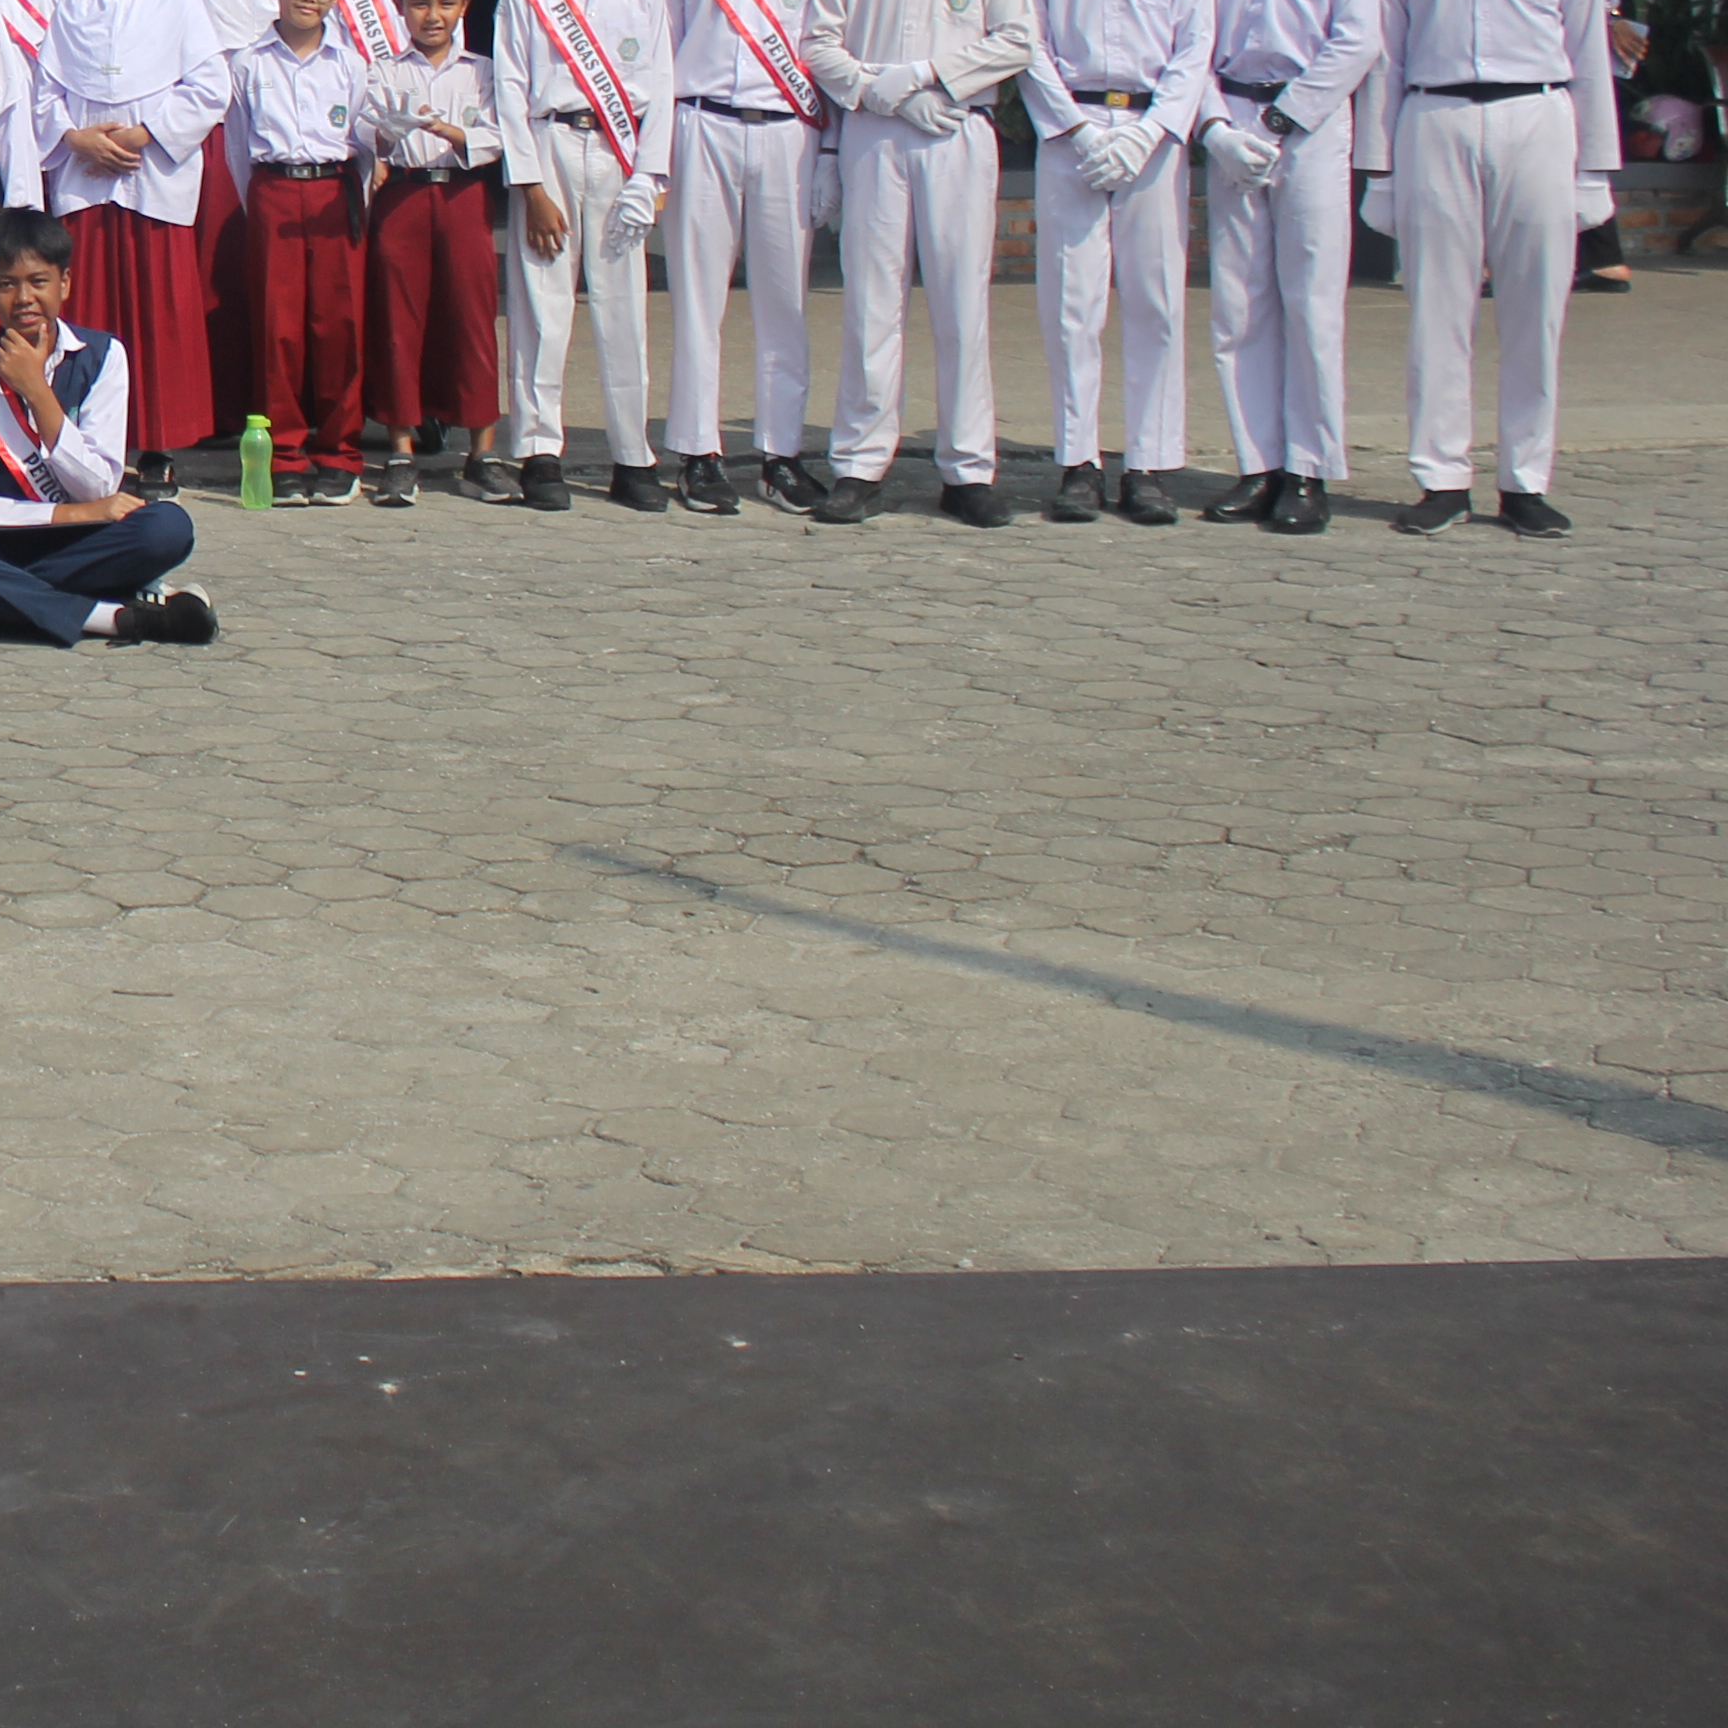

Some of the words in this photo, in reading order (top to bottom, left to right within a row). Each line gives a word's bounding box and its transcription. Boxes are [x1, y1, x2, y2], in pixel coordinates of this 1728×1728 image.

[551, 2, 601, 71] PETUGAS
[591, 70, 632, 140] UPACARA
[763, 32, 813, 101] PETUGAS
[23, 451, 64, 503] PETUG
